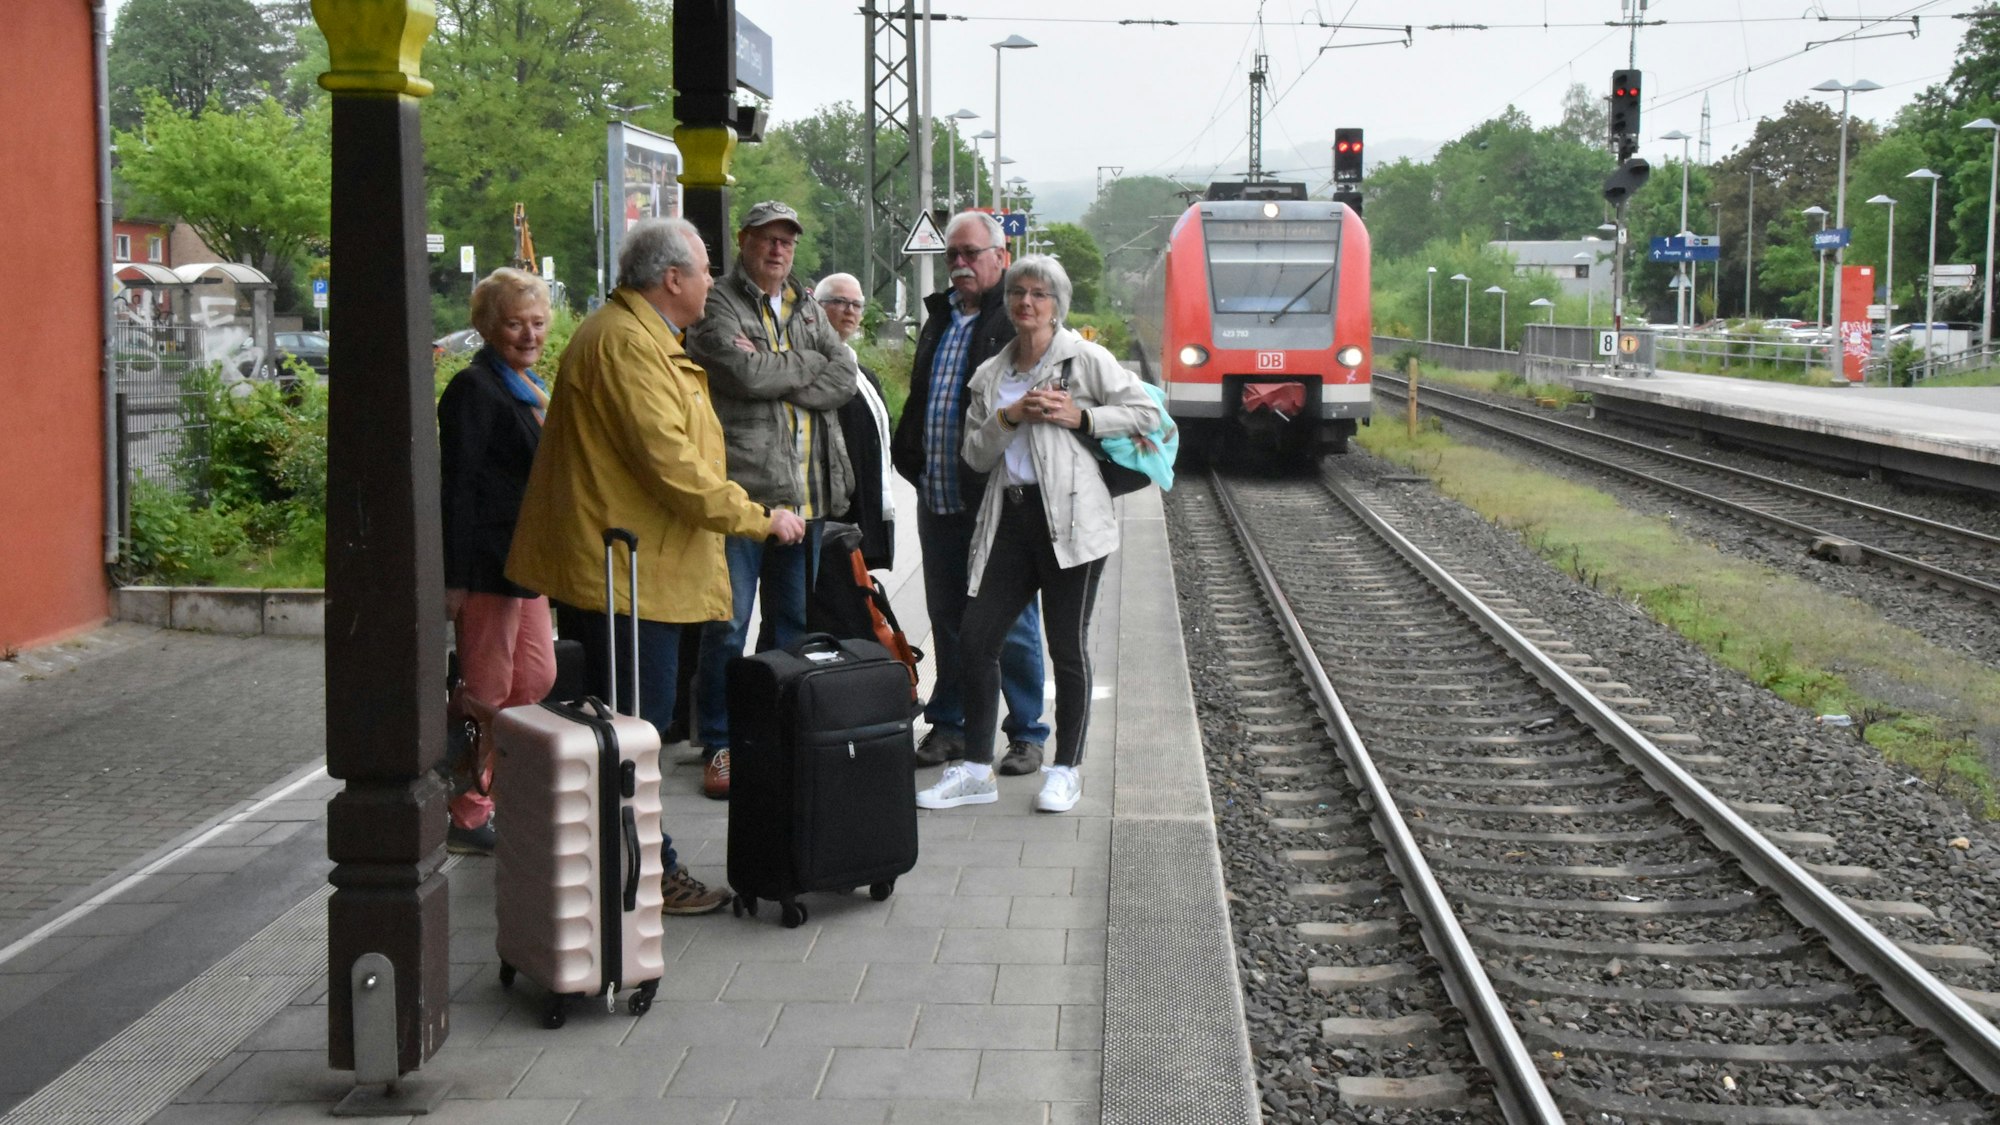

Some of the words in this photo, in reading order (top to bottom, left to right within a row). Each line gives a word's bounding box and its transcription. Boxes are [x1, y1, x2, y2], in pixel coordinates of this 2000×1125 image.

[1664, 237, 1670, 247] 1
[316, 282, 324, 292] P
[1604, 334, 1613, 352] 8
[1260, 354, 1283, 368] DB
